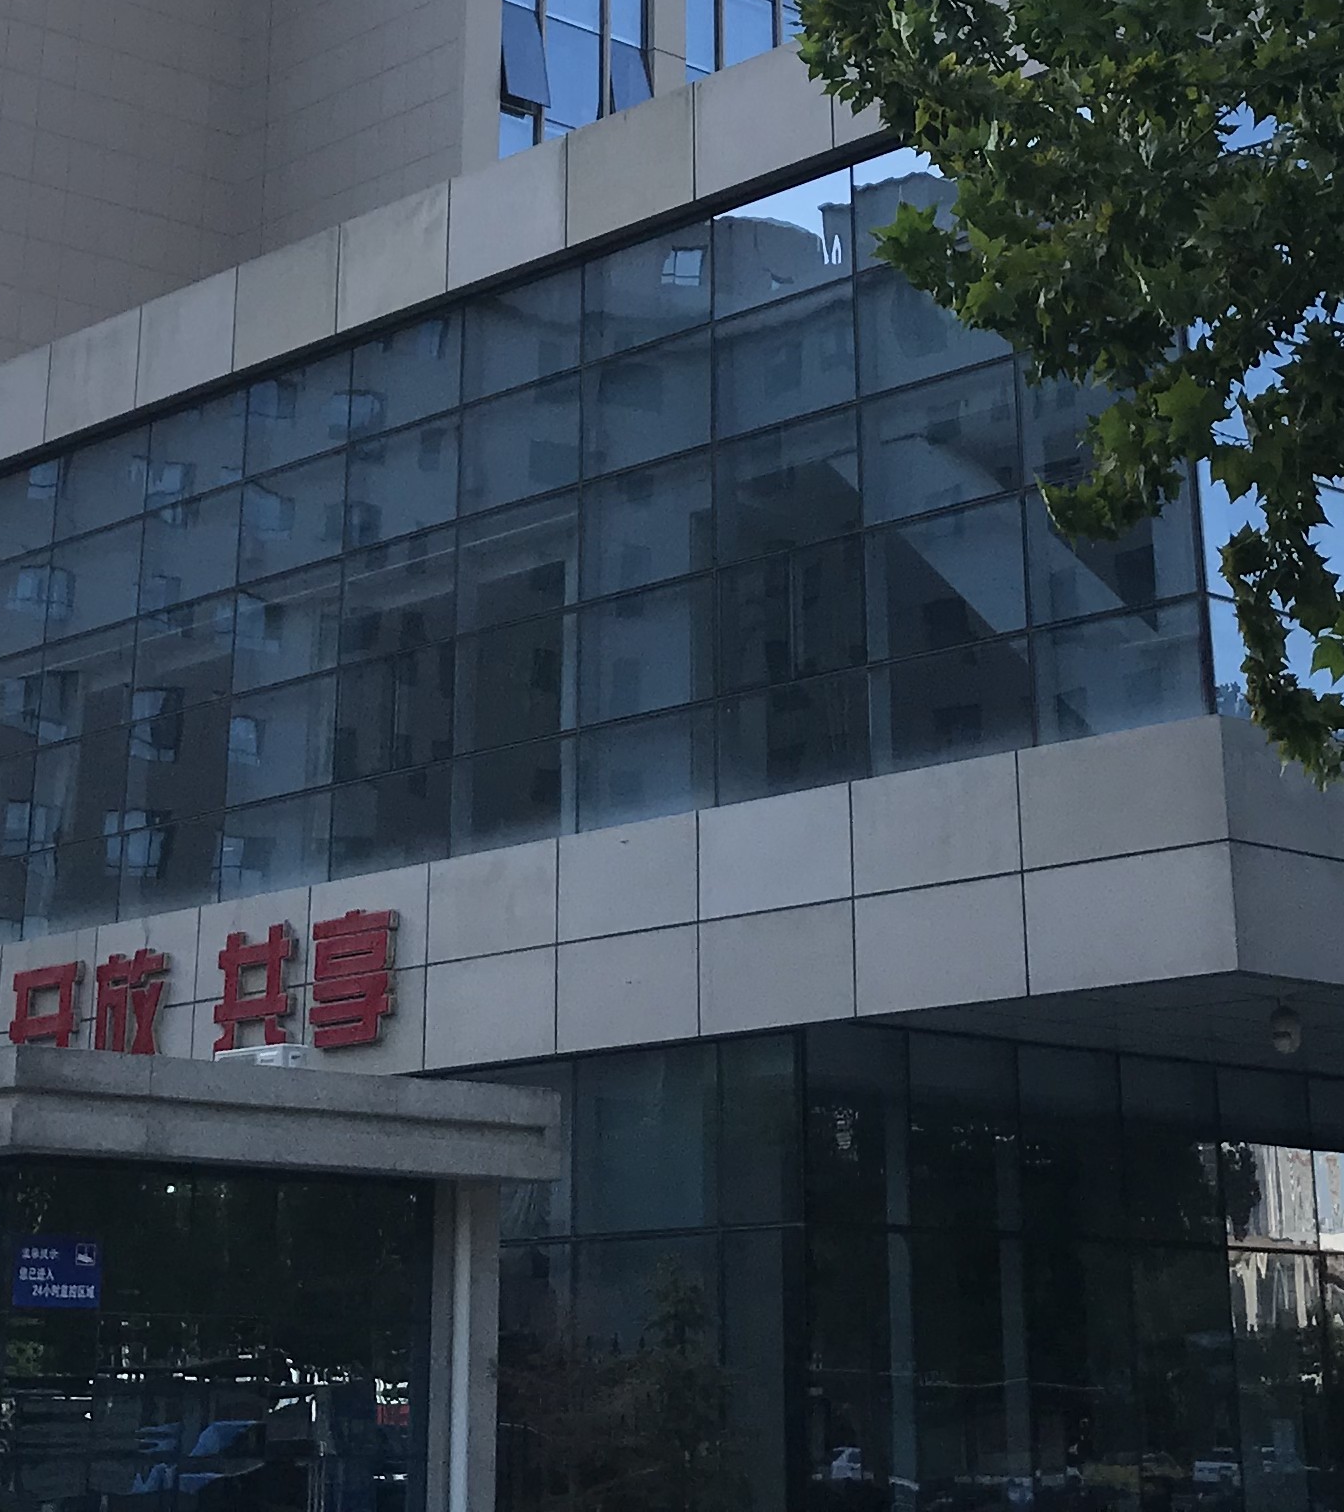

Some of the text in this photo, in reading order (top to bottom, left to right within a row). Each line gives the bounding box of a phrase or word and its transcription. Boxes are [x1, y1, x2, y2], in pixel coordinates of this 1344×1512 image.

[10, 949, 171, 1055] 开放
[214, 910, 398, 1052] 共享
[19, 1267, 55, 1281] 您已进入
